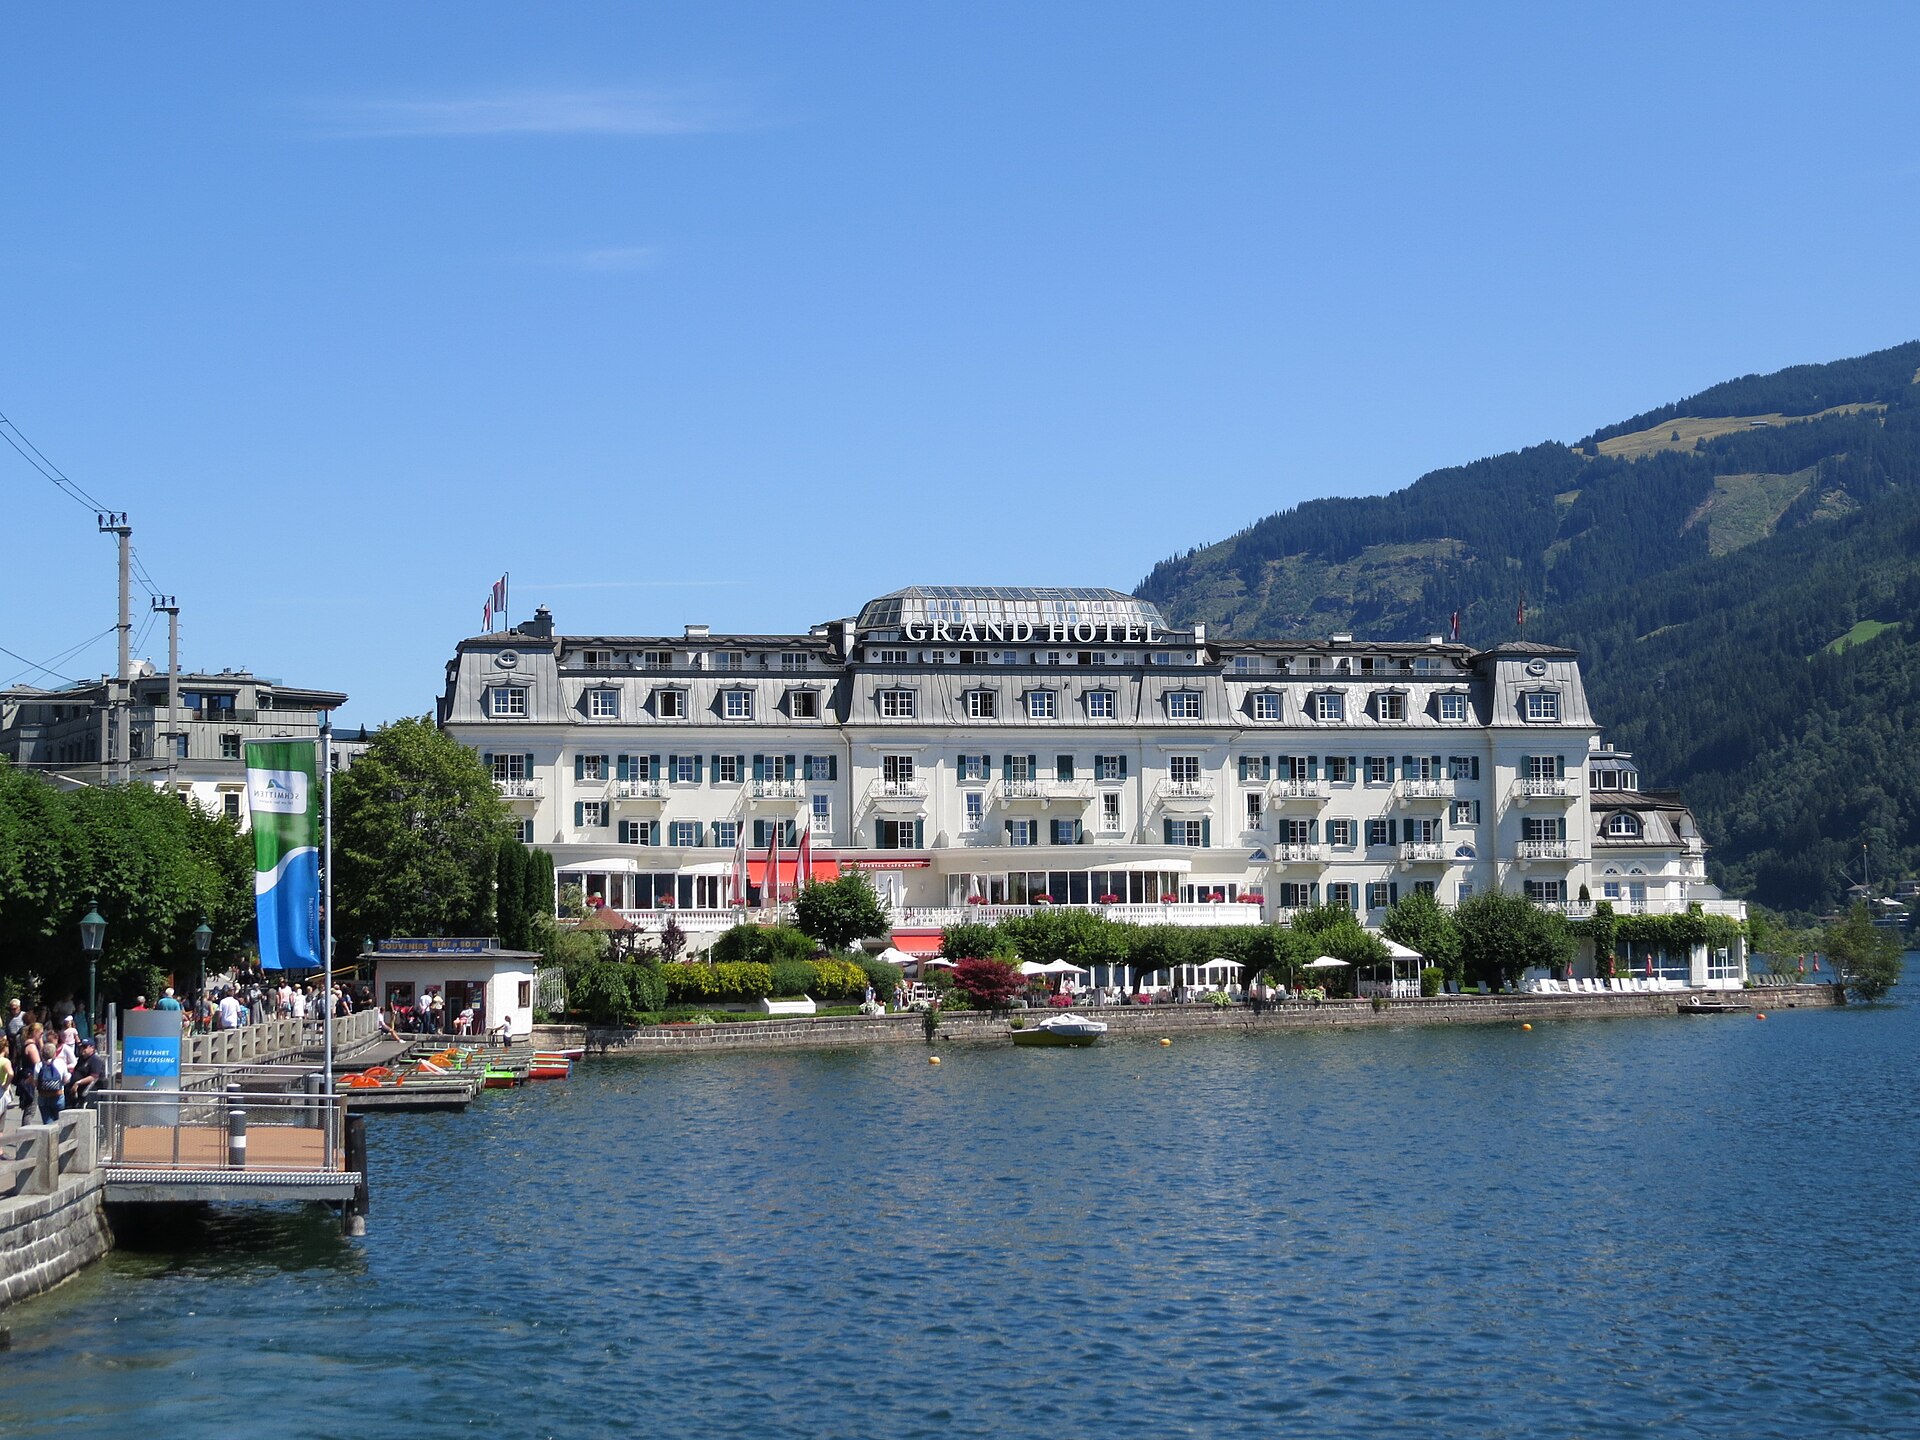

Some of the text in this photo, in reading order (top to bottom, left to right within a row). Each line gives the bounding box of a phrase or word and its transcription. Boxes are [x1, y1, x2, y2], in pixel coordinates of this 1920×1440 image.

[905, 619, 1163, 644] GRAND HOTEL
[432, 940, 451, 948] RENT
[460, 940, 480, 948] BOAT
